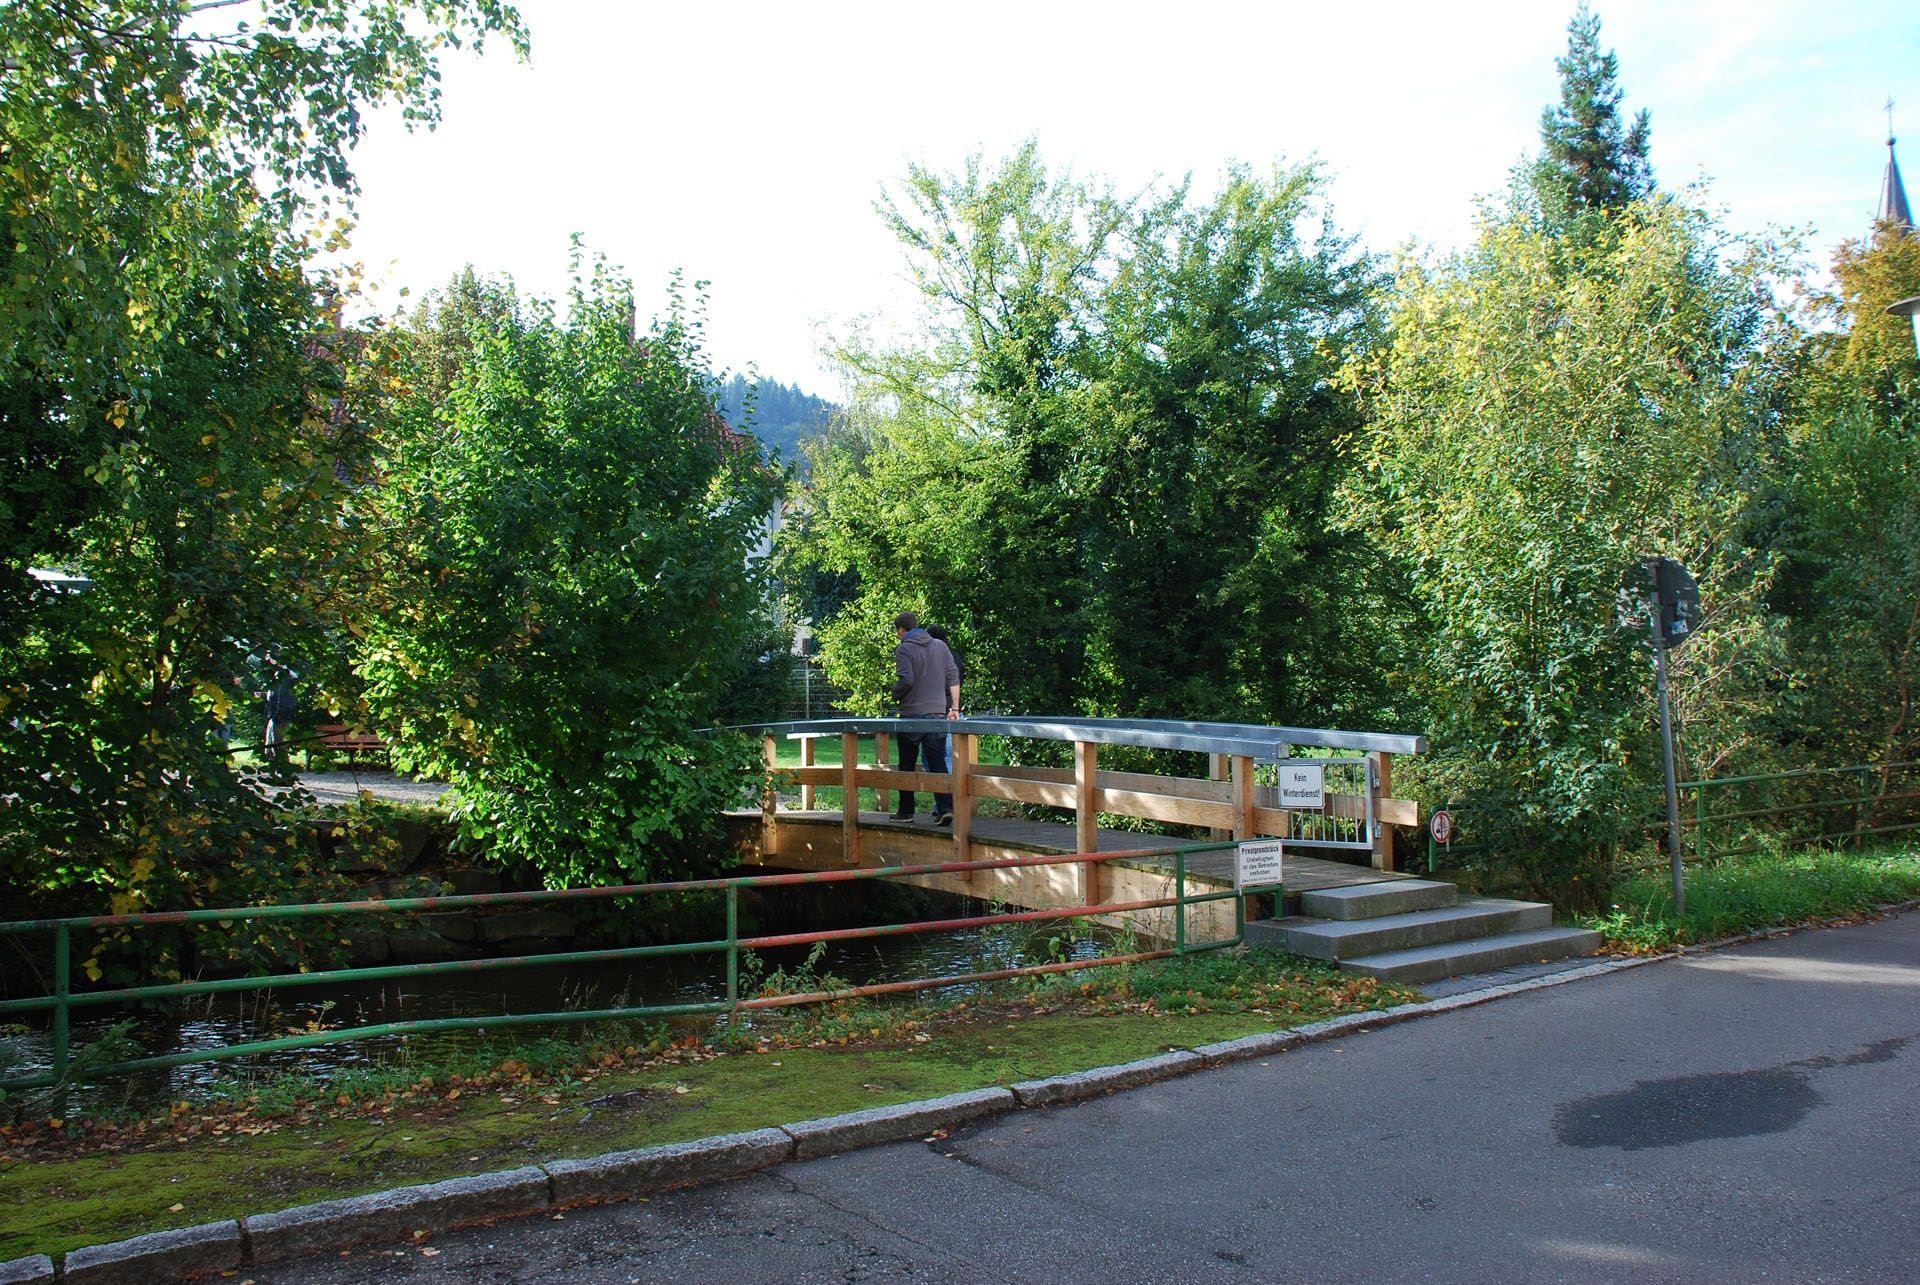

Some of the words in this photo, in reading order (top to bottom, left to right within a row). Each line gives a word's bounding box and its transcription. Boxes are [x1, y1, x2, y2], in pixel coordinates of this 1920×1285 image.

[1294, 773, 1307, 782] Kein
[1283, 788, 1320, 798] Winterdienst!
[1241, 846, 1279, 855] Privatgrundstück
